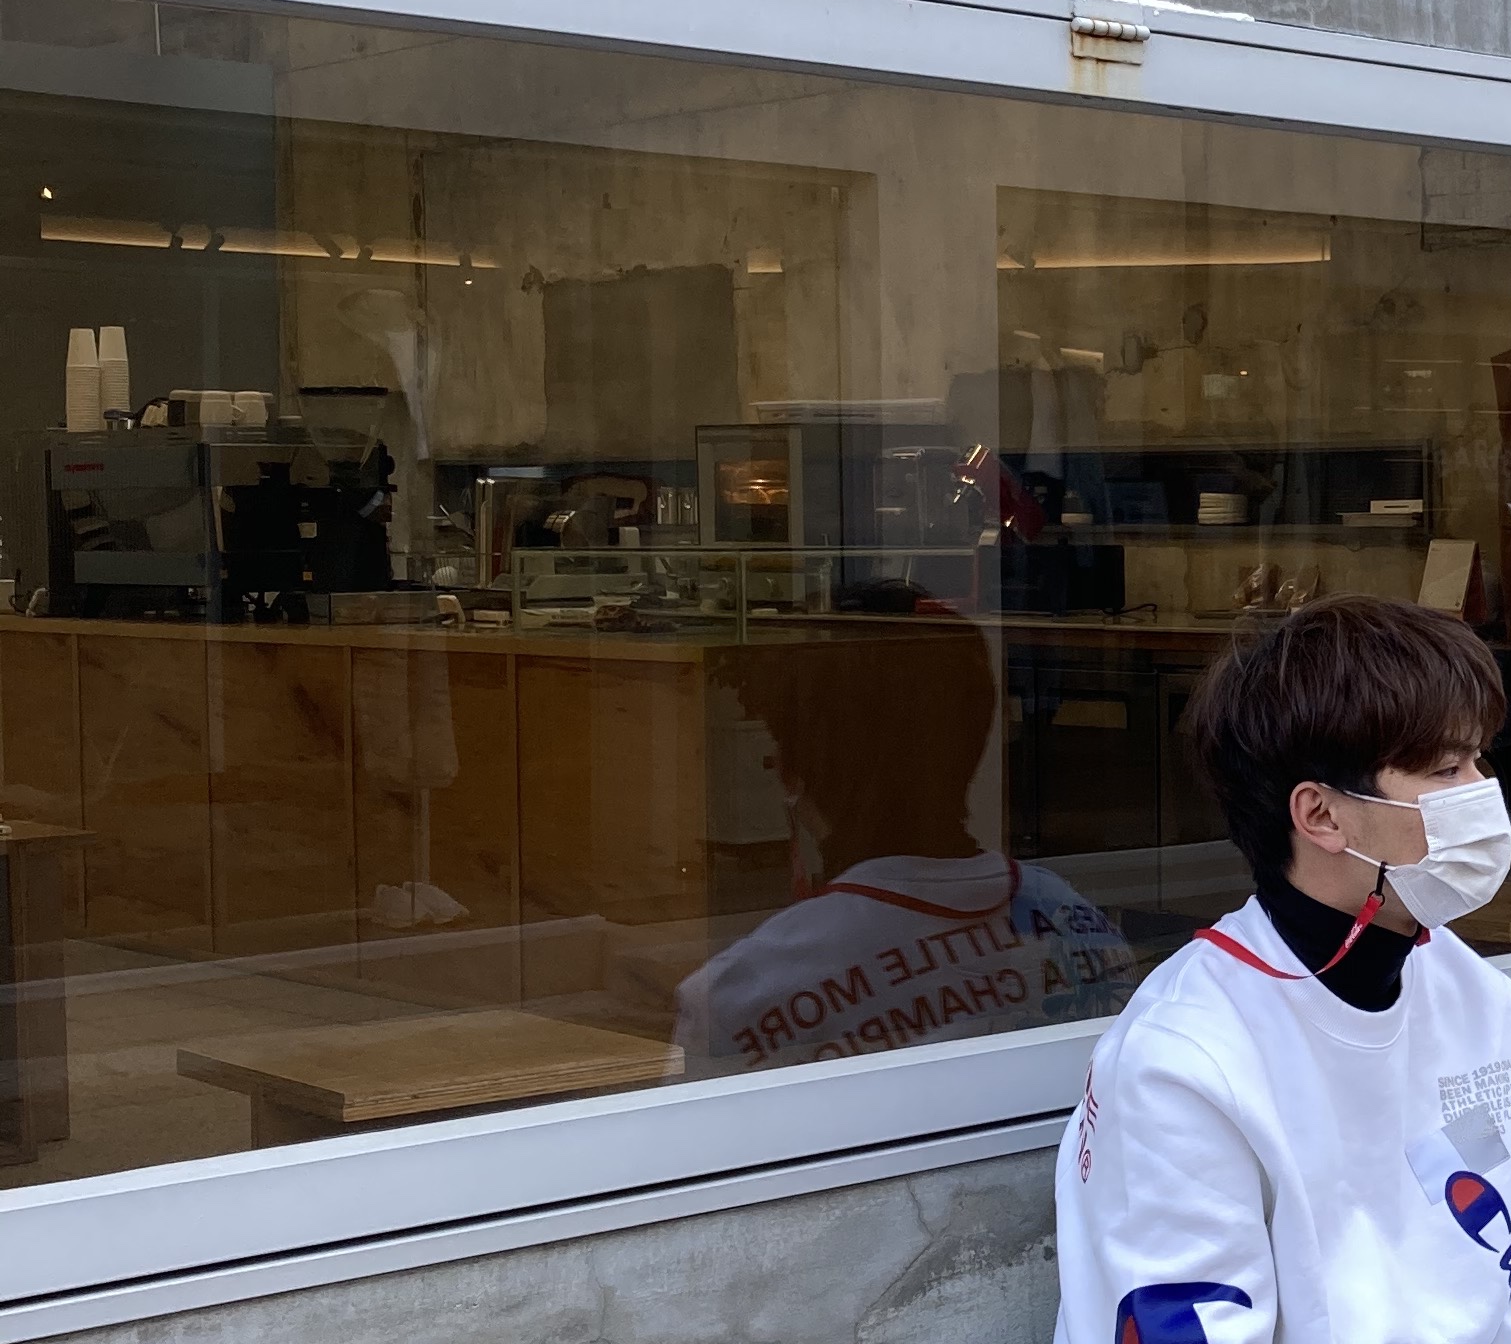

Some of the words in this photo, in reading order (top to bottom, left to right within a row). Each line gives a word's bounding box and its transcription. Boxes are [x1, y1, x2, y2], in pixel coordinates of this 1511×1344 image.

[1438, 1073, 1470, 1088] SINCE
[1472, 1061, 1501, 1080] 1919
[1439, 1085, 1472, 1100] BEEN
[1441, 1086, 1502, 1113] ATHLETIC
